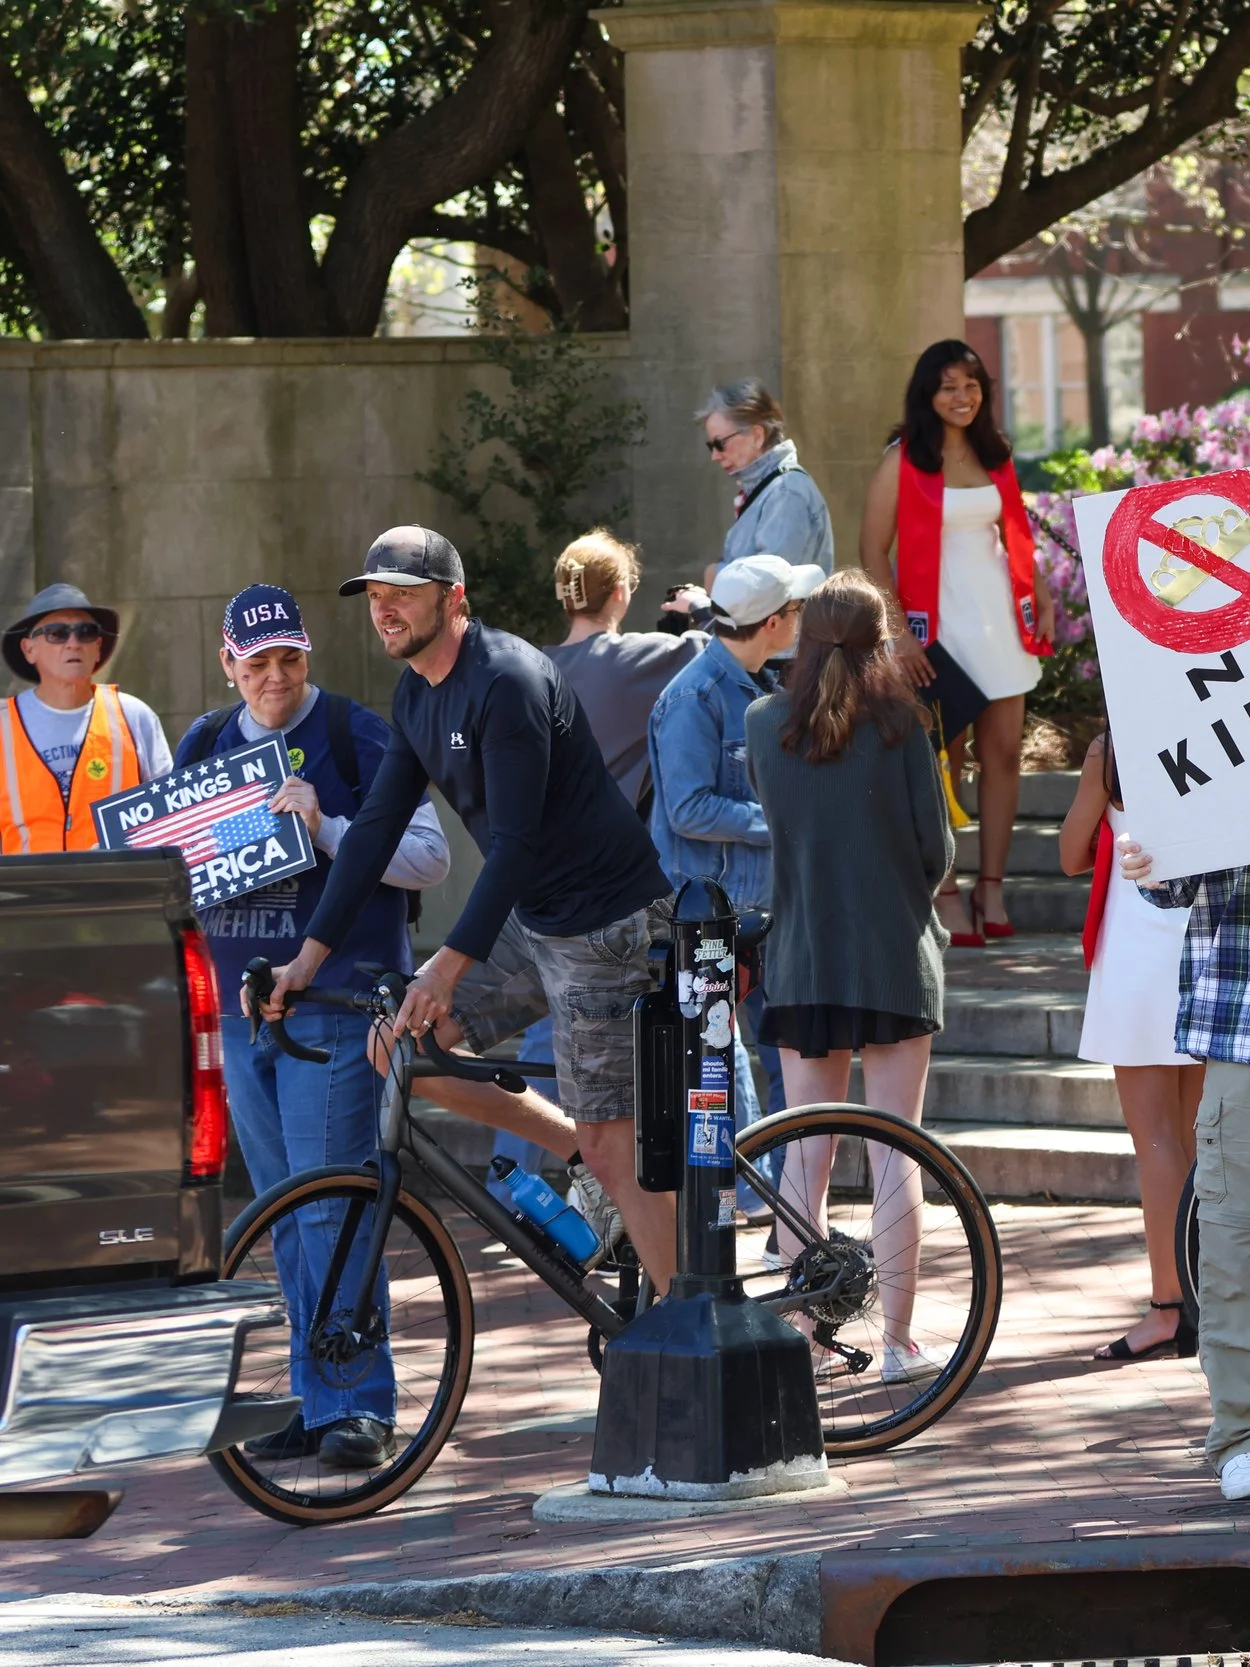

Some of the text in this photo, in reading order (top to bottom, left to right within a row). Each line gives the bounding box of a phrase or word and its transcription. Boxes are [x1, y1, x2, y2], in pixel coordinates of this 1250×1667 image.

[243, 602, 290, 627] USA
[43, 744, 80, 763] ECTIN
[119, 758, 266, 831] NO KINGS IN
[190, 836, 288, 895] ERICA
[201, 909, 297, 939] MERICA
[701, 939, 723, 950] FINE
[98, 1227, 155, 1245] SLE
